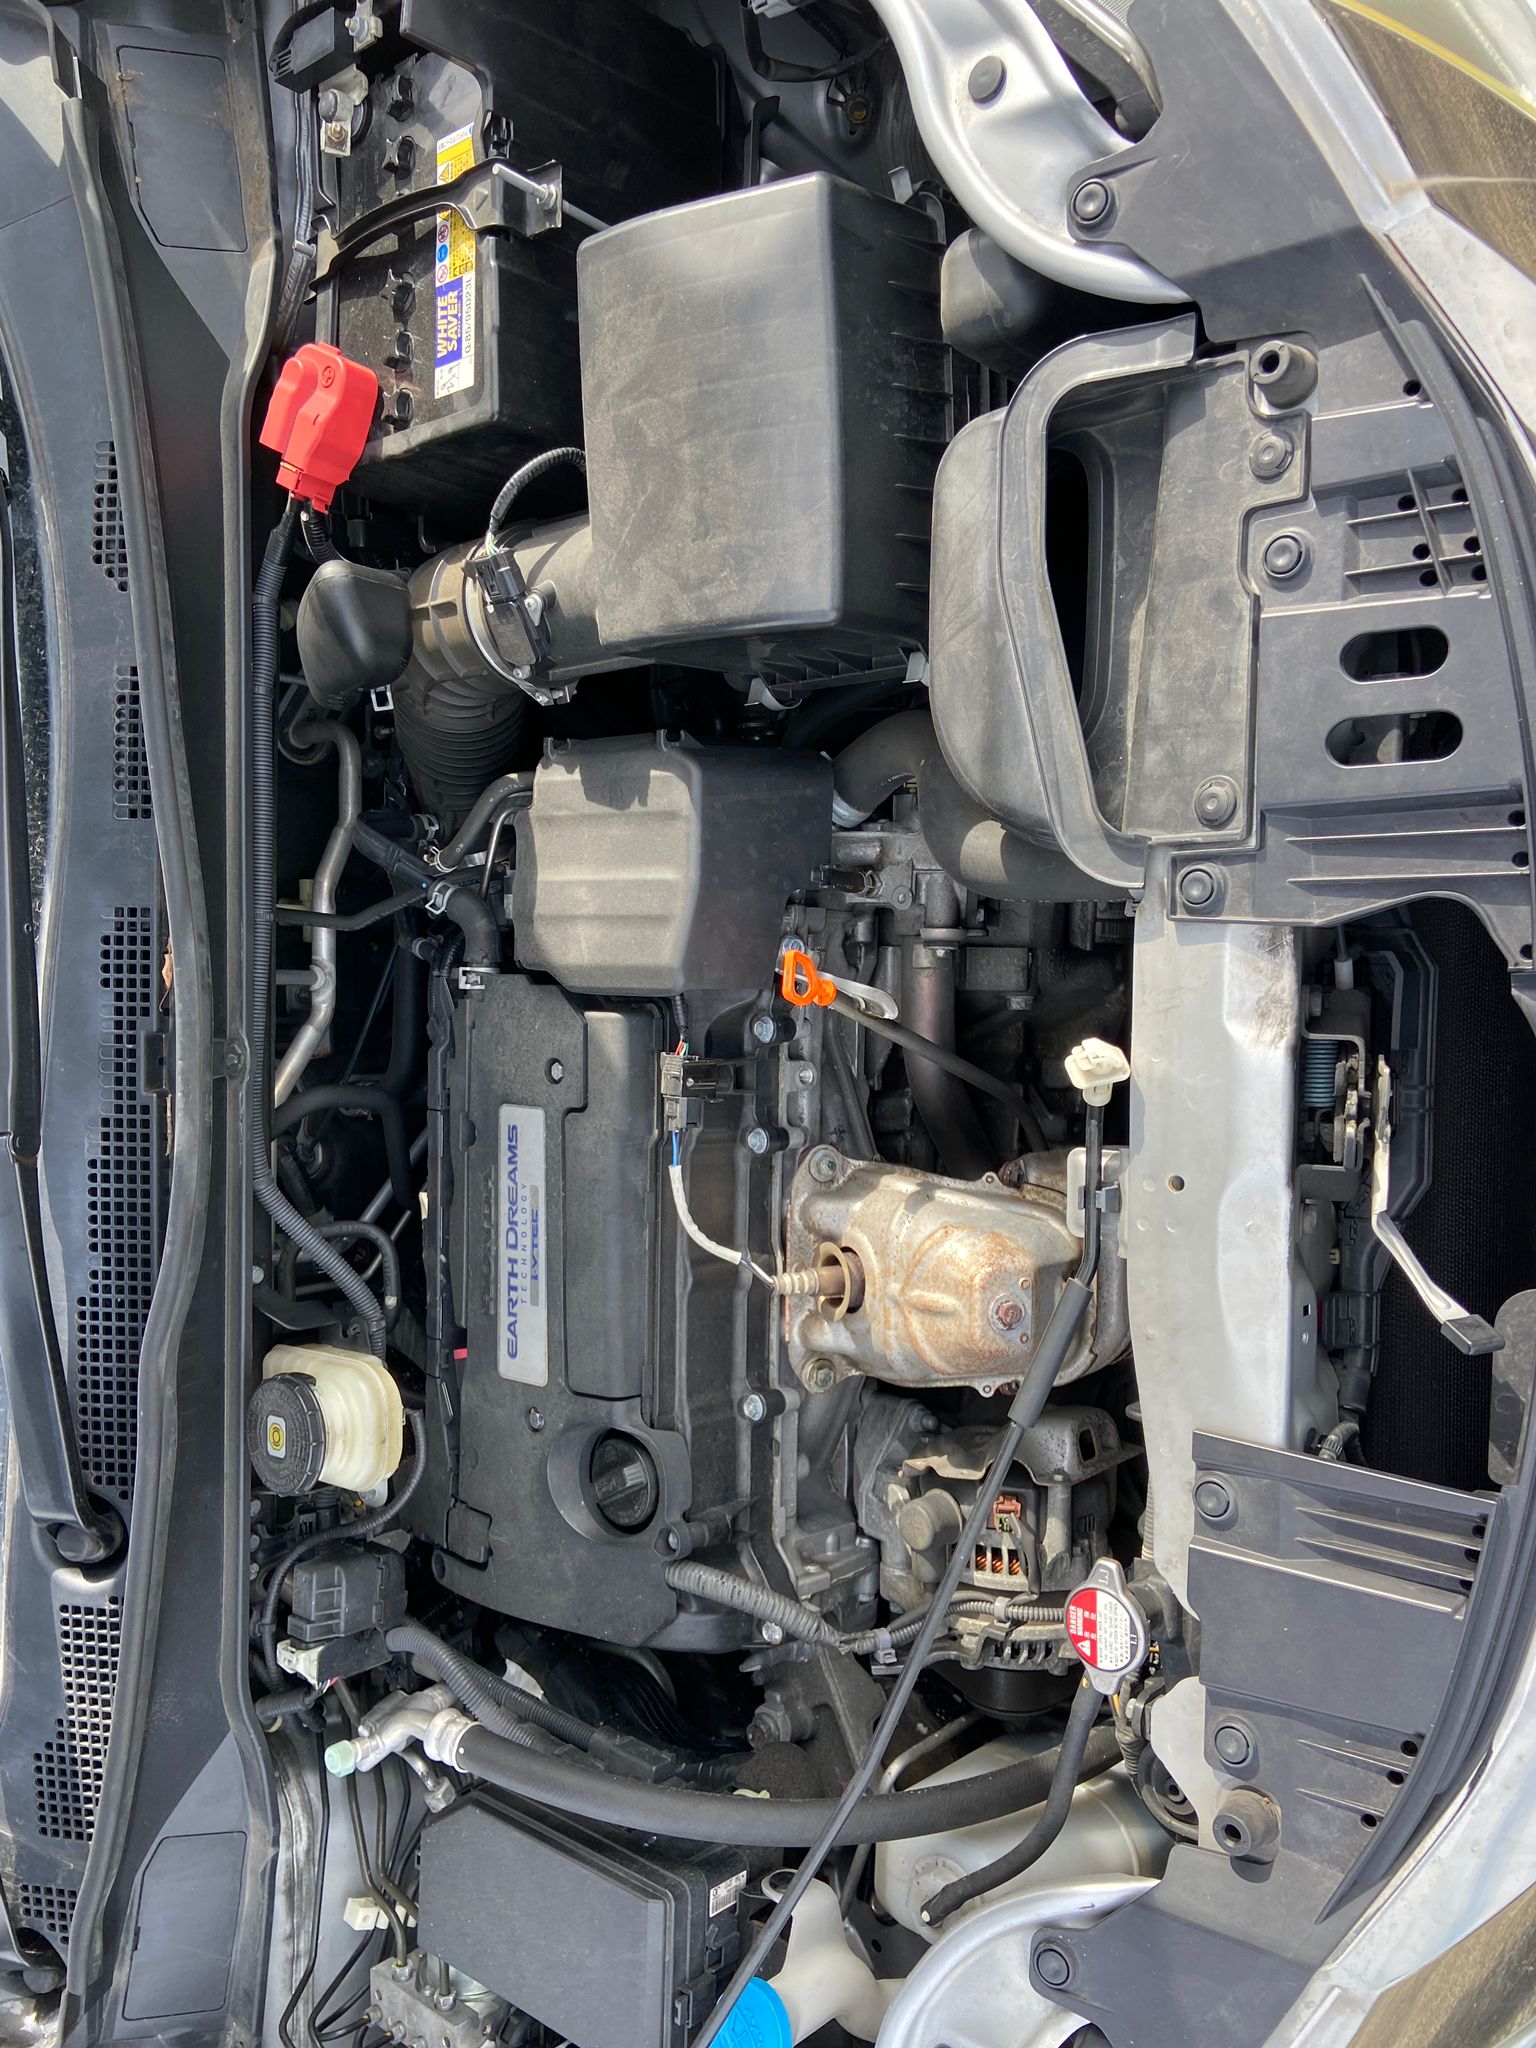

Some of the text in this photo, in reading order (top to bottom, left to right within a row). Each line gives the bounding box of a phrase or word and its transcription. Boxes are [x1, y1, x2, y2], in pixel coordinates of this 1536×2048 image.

[436, 295, 448, 359] WHITE
[448, 290, 458, 351] SAVER
[464, 276, 473, 354] Q-85/95D23L
[505, 1123, 519, 1360] EARTH DREAMS
[520, 1182, 528, 1304] TECHNOLOGY
